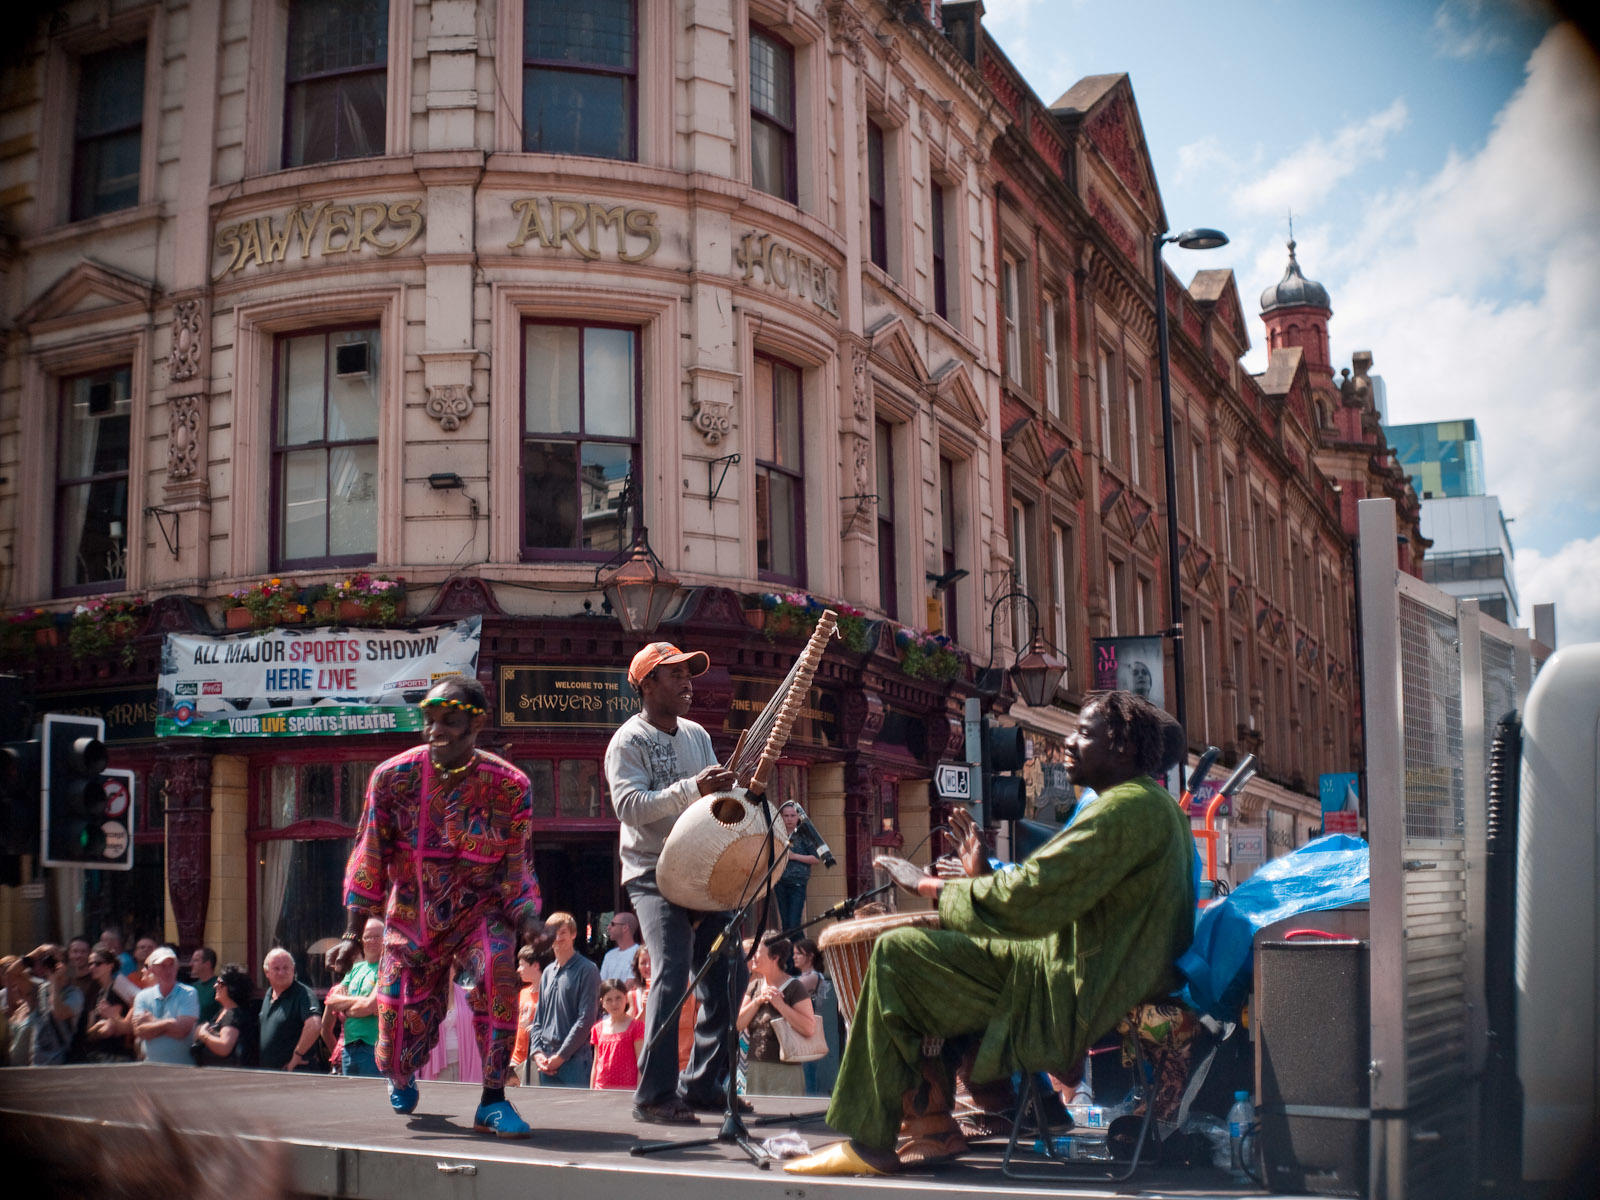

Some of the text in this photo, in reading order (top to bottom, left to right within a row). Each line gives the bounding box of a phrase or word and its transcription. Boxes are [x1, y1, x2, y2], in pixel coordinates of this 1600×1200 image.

[211, 197, 840, 319] SAWYERS ARMS HOTEL
[194, 635, 439, 665] ALL MAJOR SPORTS SHOWN
[265, 667, 357, 690] HERE LIVE
[555, 681, 619, 690] WELCOME TO THE
[519, 694, 642, 712] SAWYERS ARM
[106, 703, 157, 728] ARMS
[228, 712, 397, 733] YOUR LIVE SPORTS THEATRE
